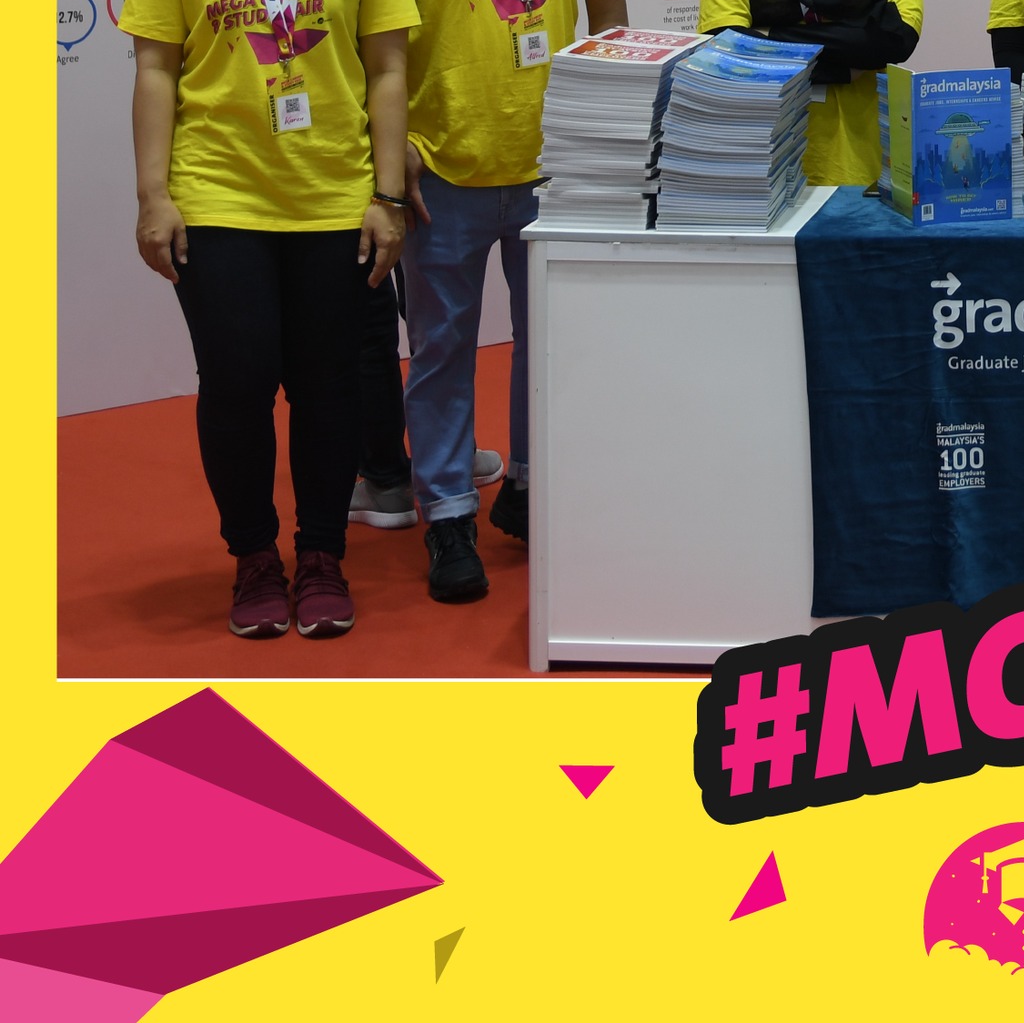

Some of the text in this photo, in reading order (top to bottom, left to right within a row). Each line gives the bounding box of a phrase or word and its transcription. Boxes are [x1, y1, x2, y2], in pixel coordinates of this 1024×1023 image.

[920, 77, 1001, 98] gradmalaysia
[268, 94, 278, 133] ORGANISER
[948, 355, 1019, 370] Graduate
[936, 423, 985, 433] gradmalaysia
[937, 436, 985, 446] MALAYSIA'S
[940, 447, 984, 471] 100
[960, 470, 986, 478] graduate
[939, 478, 986, 488] EMPLOYERS
